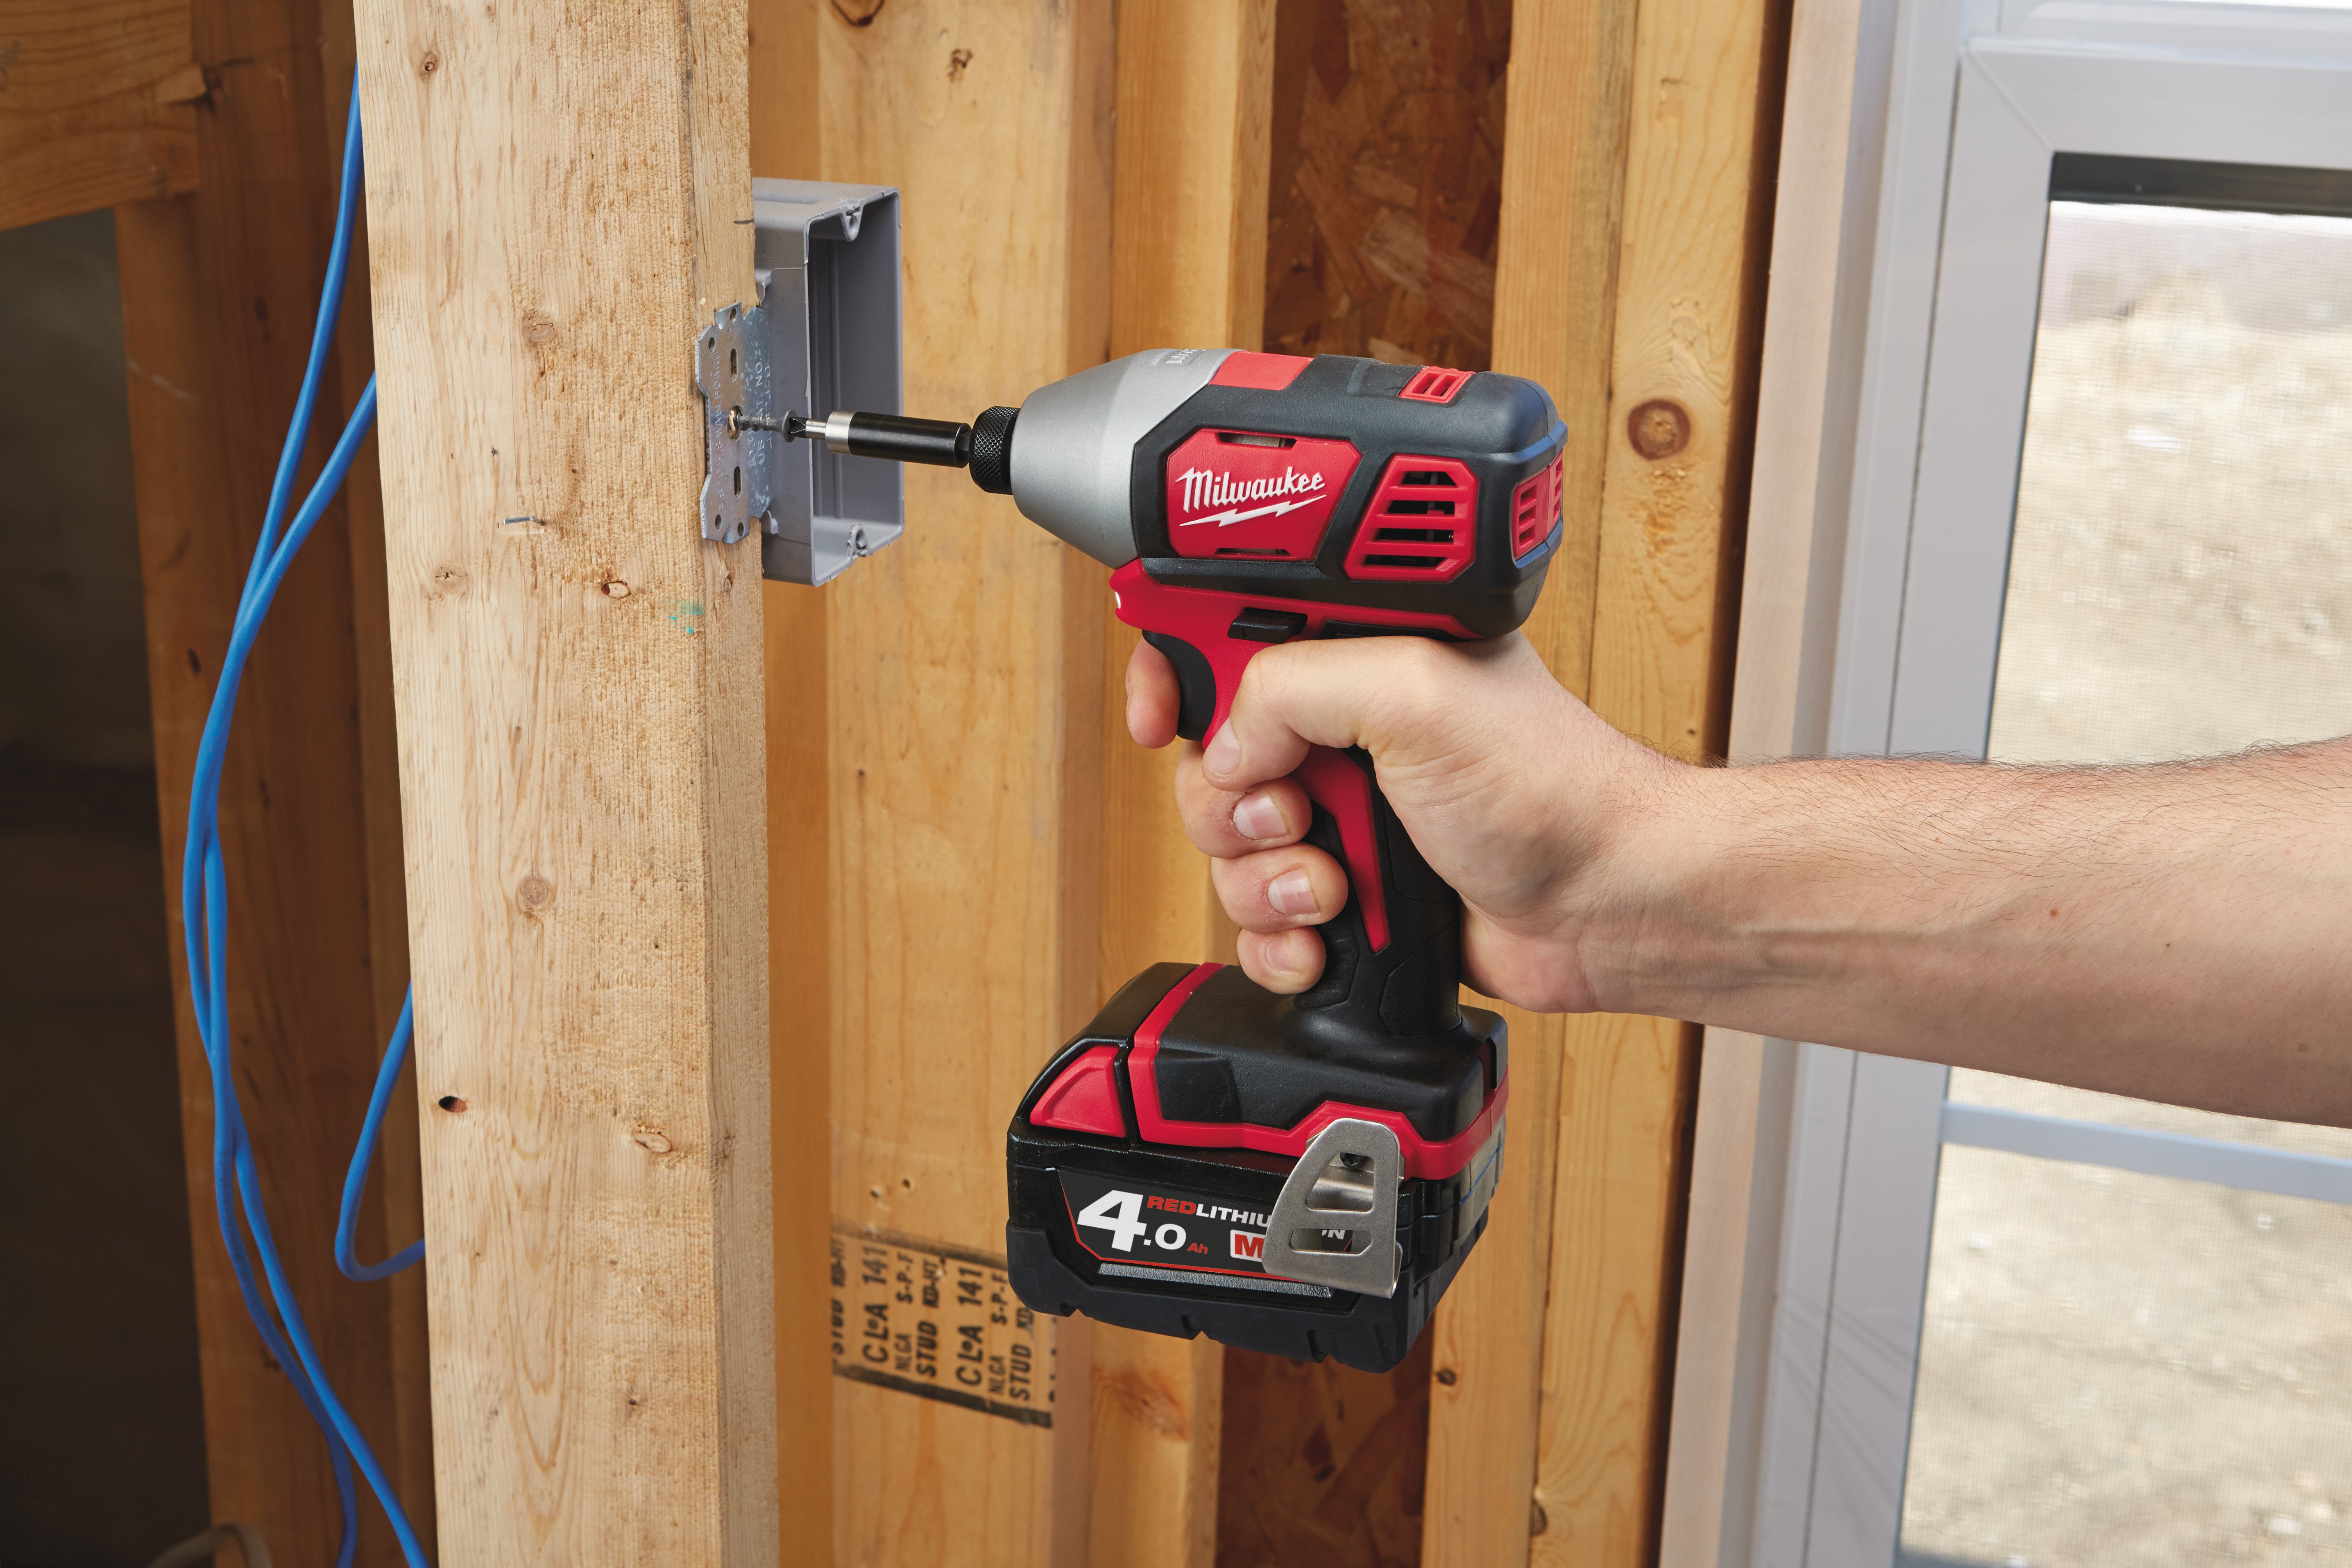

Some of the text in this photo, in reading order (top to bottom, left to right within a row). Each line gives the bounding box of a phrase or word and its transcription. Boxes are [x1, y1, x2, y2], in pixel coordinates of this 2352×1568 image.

[714, 351, 722, 438] WALLBOARD
[758, 440, 765, 465] US
[1175, 466, 1326, 514] Milwaukee
[1077, 1190, 1187, 1253] 4.0
[1187, 1242, 1209, 1254] Ah
[1147, 1195, 1271, 1228] REDLITHIU
[862, 1246, 888, 1284] 141
[896, 1251, 913, 1304] S-P-F
[957, 1267, 982, 1305] 141
[991, 1272, 1008, 1325] S-P-F
[916, 1320, 938, 1378] STUD
[1009, 1344, 1031, 1401] STUD
